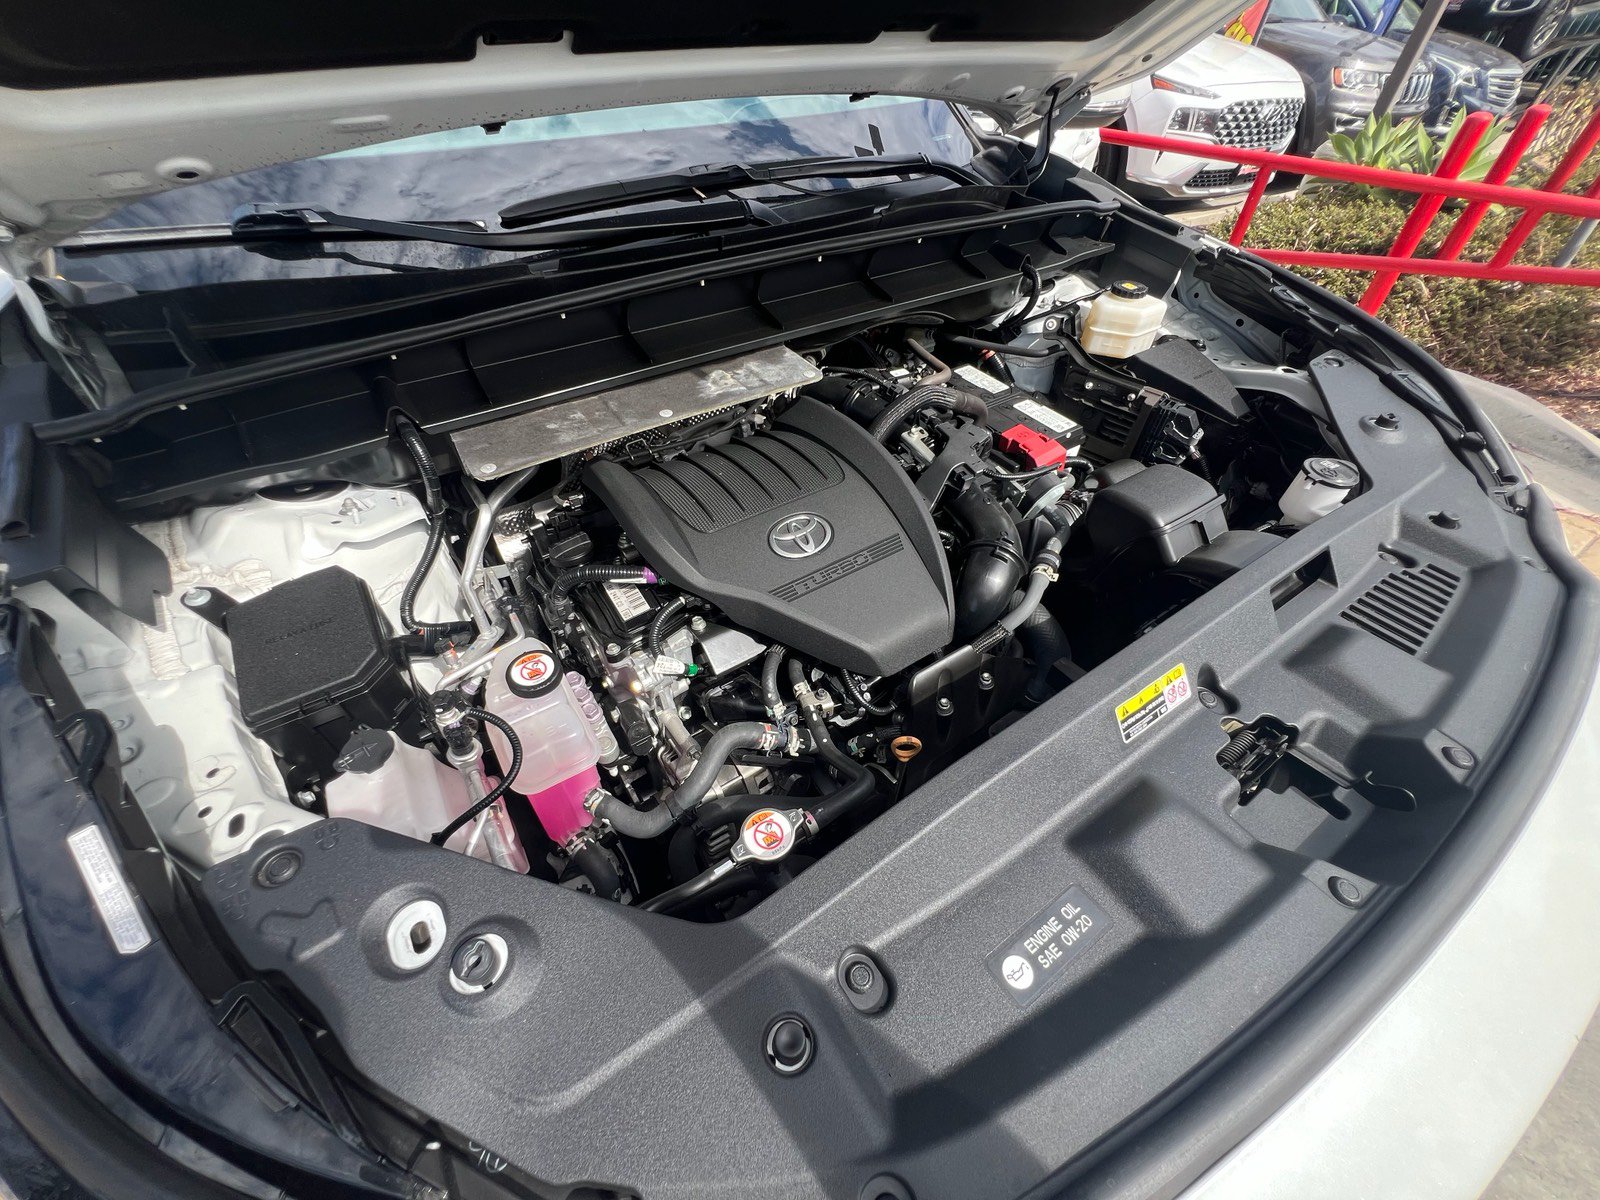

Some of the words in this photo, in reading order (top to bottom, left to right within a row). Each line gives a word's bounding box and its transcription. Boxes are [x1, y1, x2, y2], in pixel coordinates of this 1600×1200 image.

[793, 552, 871, 592] TURBO
[1023, 916, 1063, 955] ENGINE
[1060, 902, 1081, 920] OIL
[1037, 942, 1063, 969] SAE
[1060, 914, 1093, 946] 0W-20
